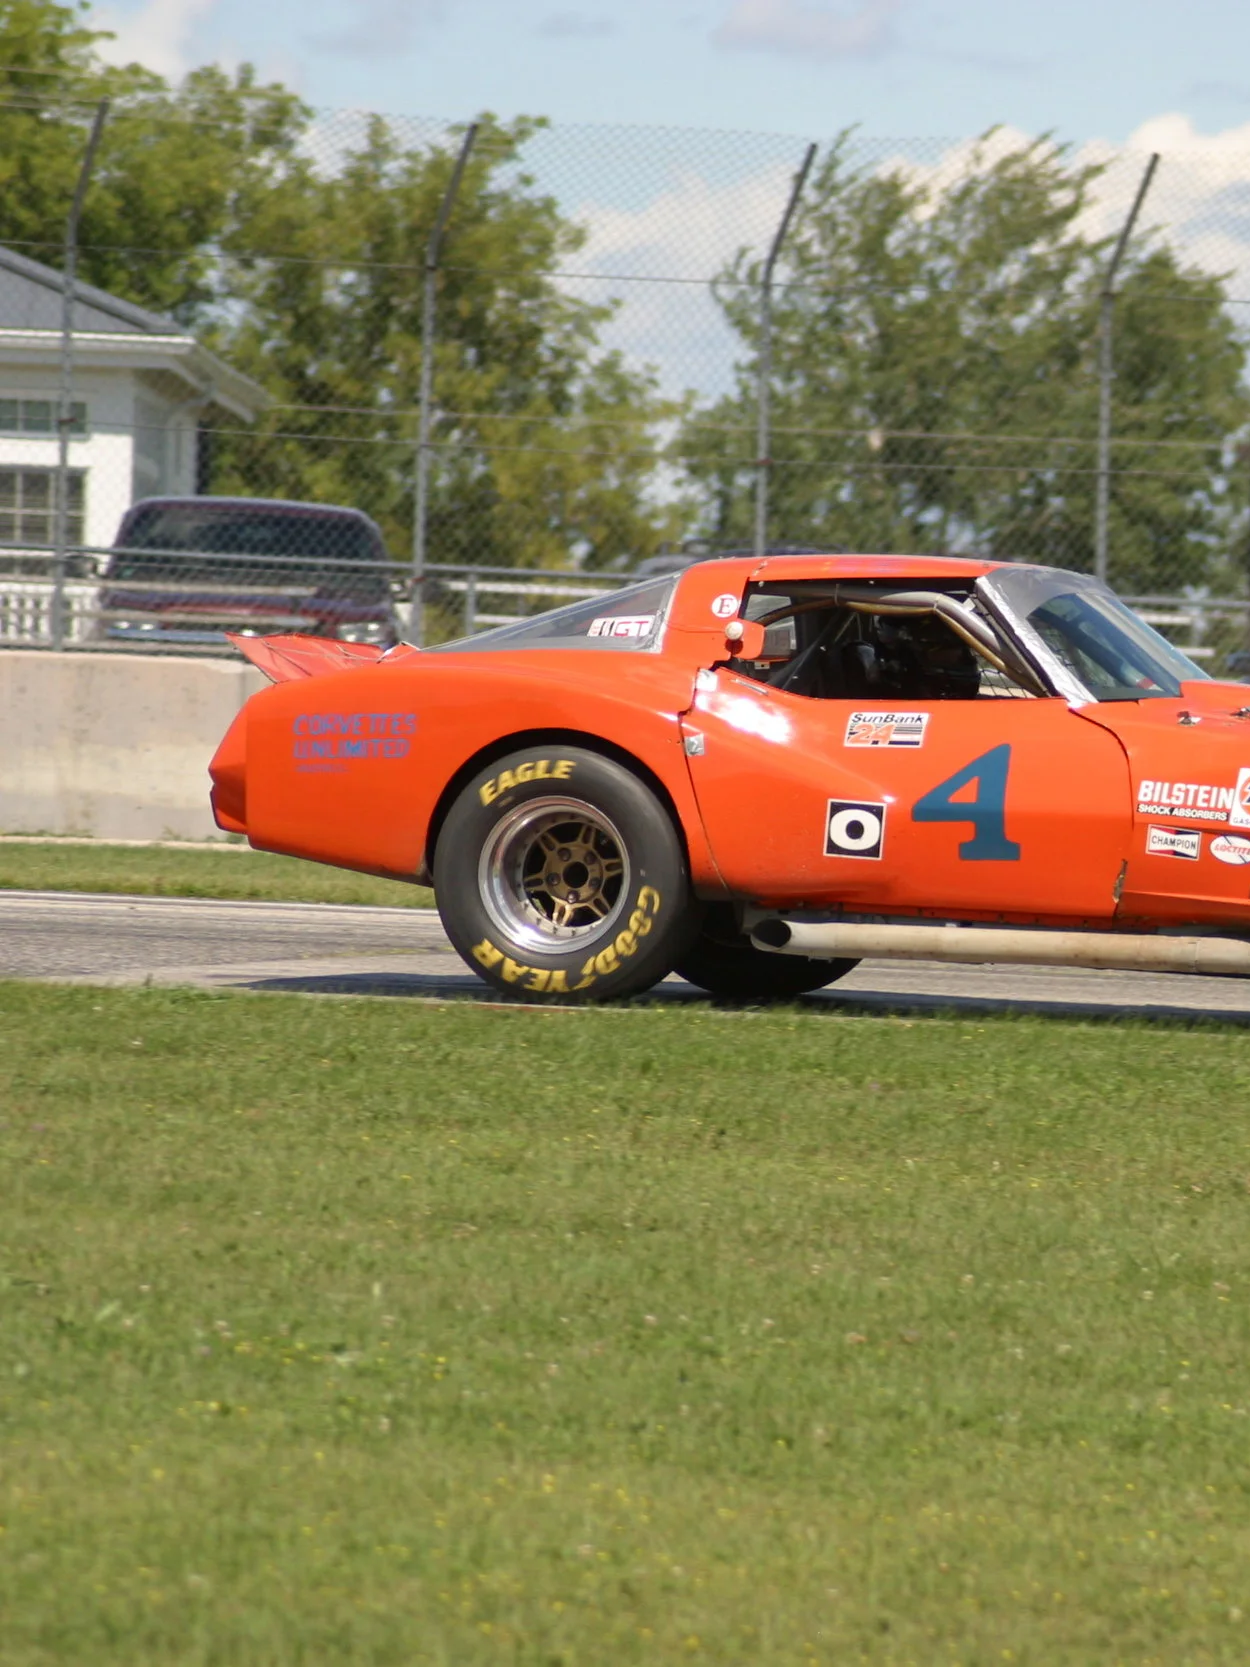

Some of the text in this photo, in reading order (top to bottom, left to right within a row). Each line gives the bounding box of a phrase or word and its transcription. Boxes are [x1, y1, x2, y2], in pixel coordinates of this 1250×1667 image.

[718, 598, 732, 614] E
[294, 713, 417, 735] CORVETTES
[851, 713, 924, 724] SunBank
[849, 724, 896, 744] 24
[294, 738, 410, 758] UNLIMITED
[479, 760, 577, 807] EAGLE
[911, 743, 1021, 861] 4
[1138, 781, 1235, 810] BILSTEIN
[1138, 803, 1227, 821] SHOCK ABSORBERS
[1151, 835, 1197, 850] CHAMPION
